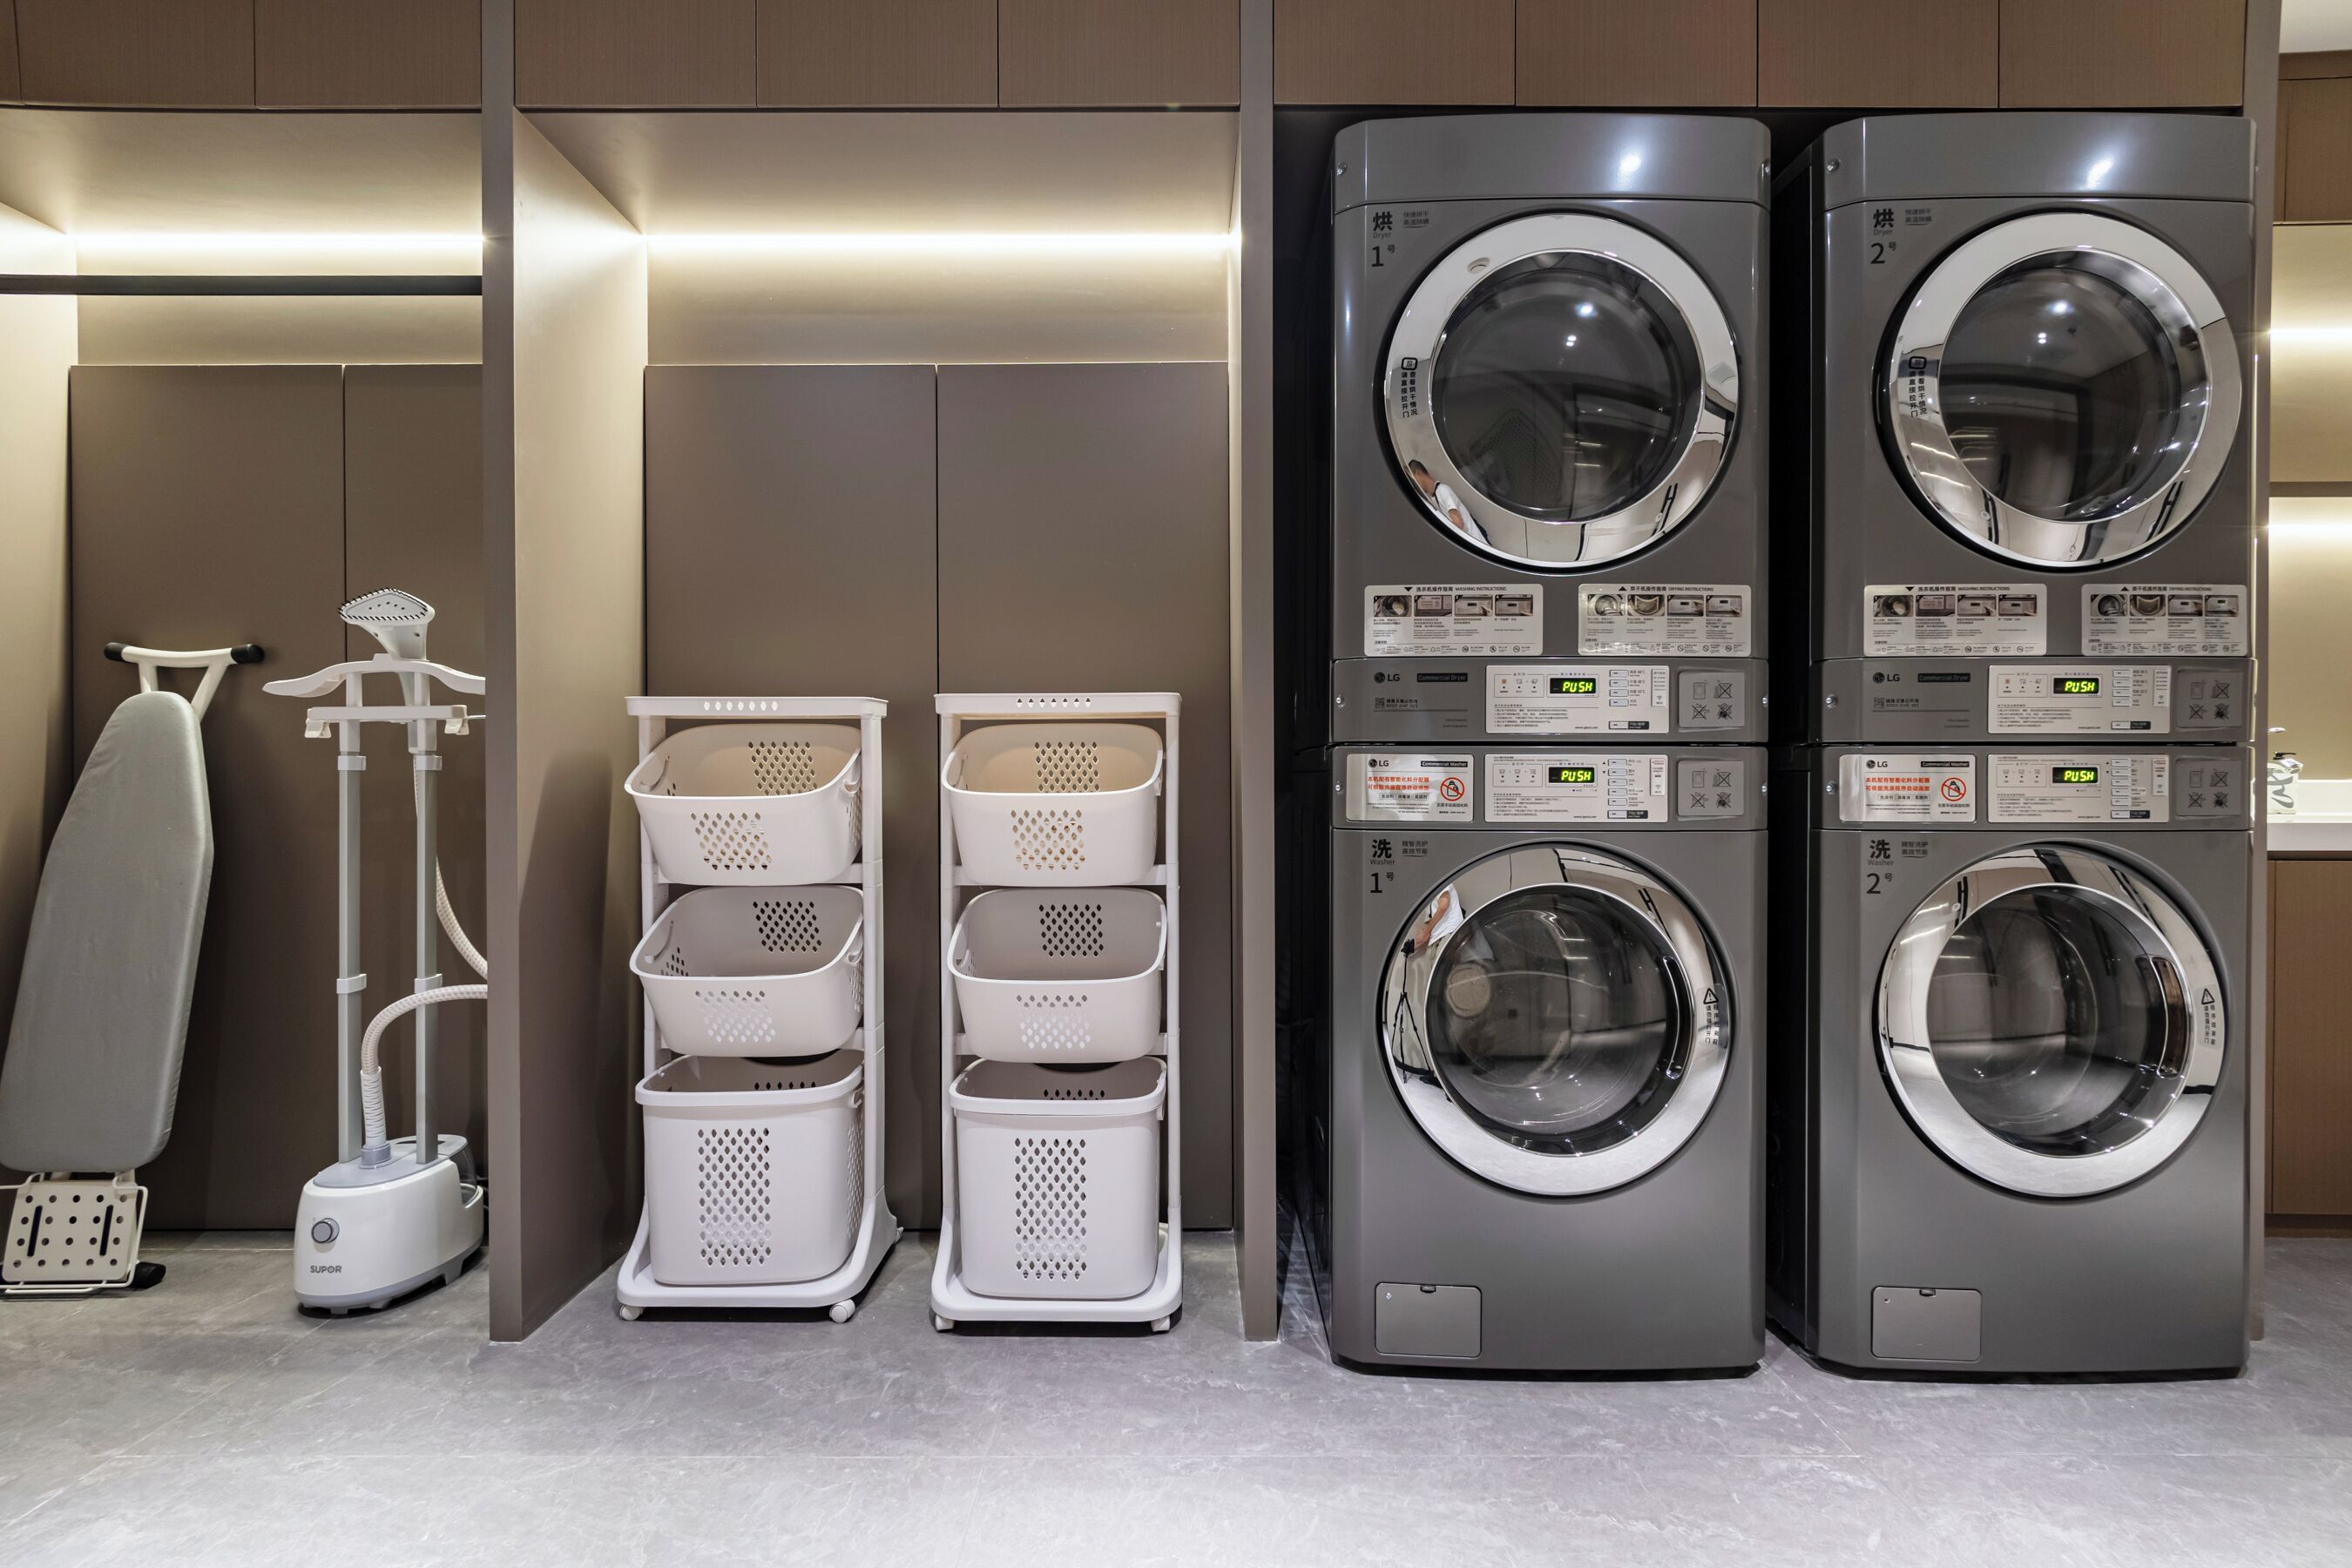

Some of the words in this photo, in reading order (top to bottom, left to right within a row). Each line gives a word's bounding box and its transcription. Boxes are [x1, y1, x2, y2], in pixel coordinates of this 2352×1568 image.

[1373, 212, 1393, 232] 烘
[1874, 208, 1895, 228] 烘
[1388, 673, 1401, 682] LG
[1886, 673, 1900, 682] LG
[1562, 681, 1593, 693] PUSH
[2064, 681, 2096, 693] PUSH
[1560, 770, 1592, 781] PUSH
[2064, 770, 2095, 781] PUSH
[1372, 839, 1392, 859] 洗
[1869, 839, 1891, 859] 洗
[310, 1265, 341, 1274] SUPOR
